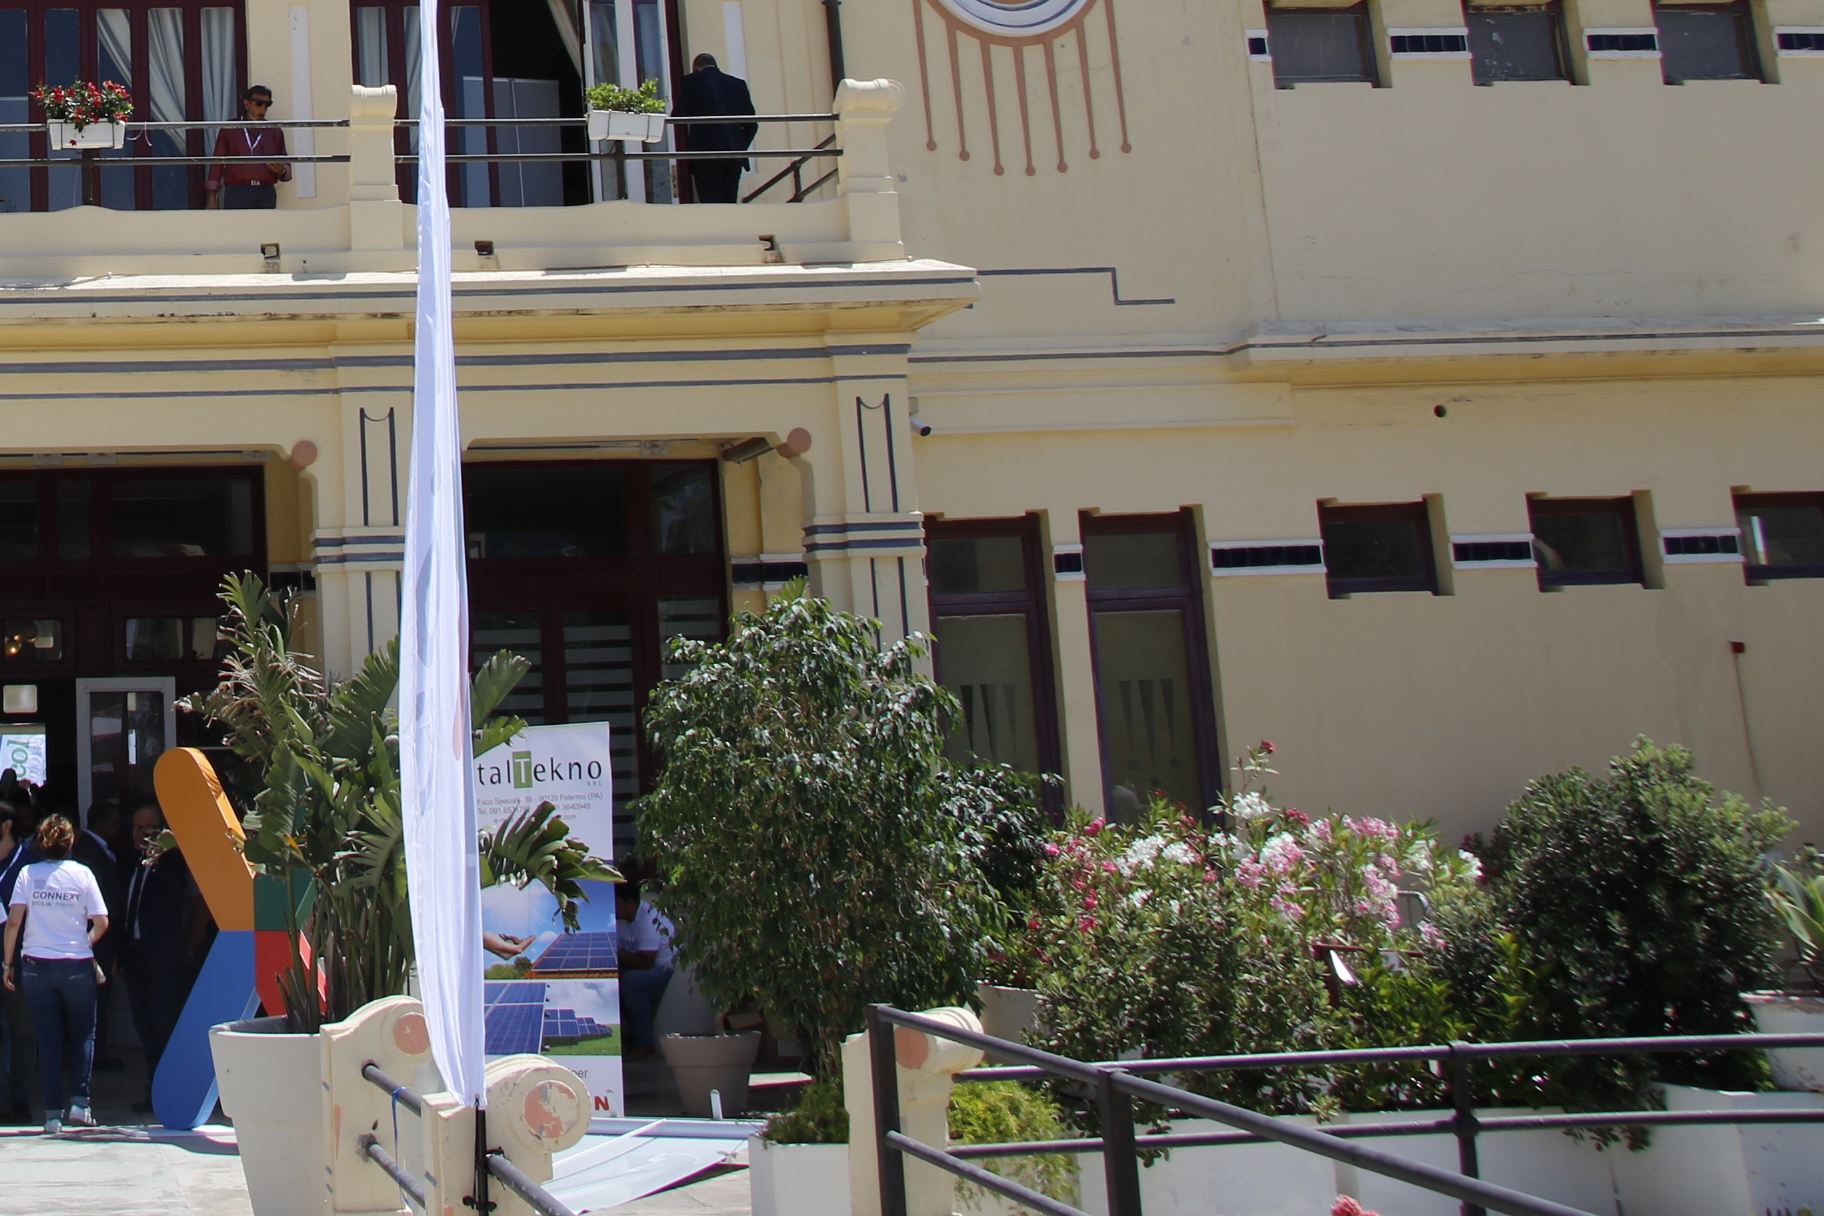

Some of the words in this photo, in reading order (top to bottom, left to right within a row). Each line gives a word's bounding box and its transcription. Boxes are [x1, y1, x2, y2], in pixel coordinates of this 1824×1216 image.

[559, 793, 587, 801] Palermo
[587, 791, 603, 801] (PA)
[32, 890, 81, 902] CONNEXT
